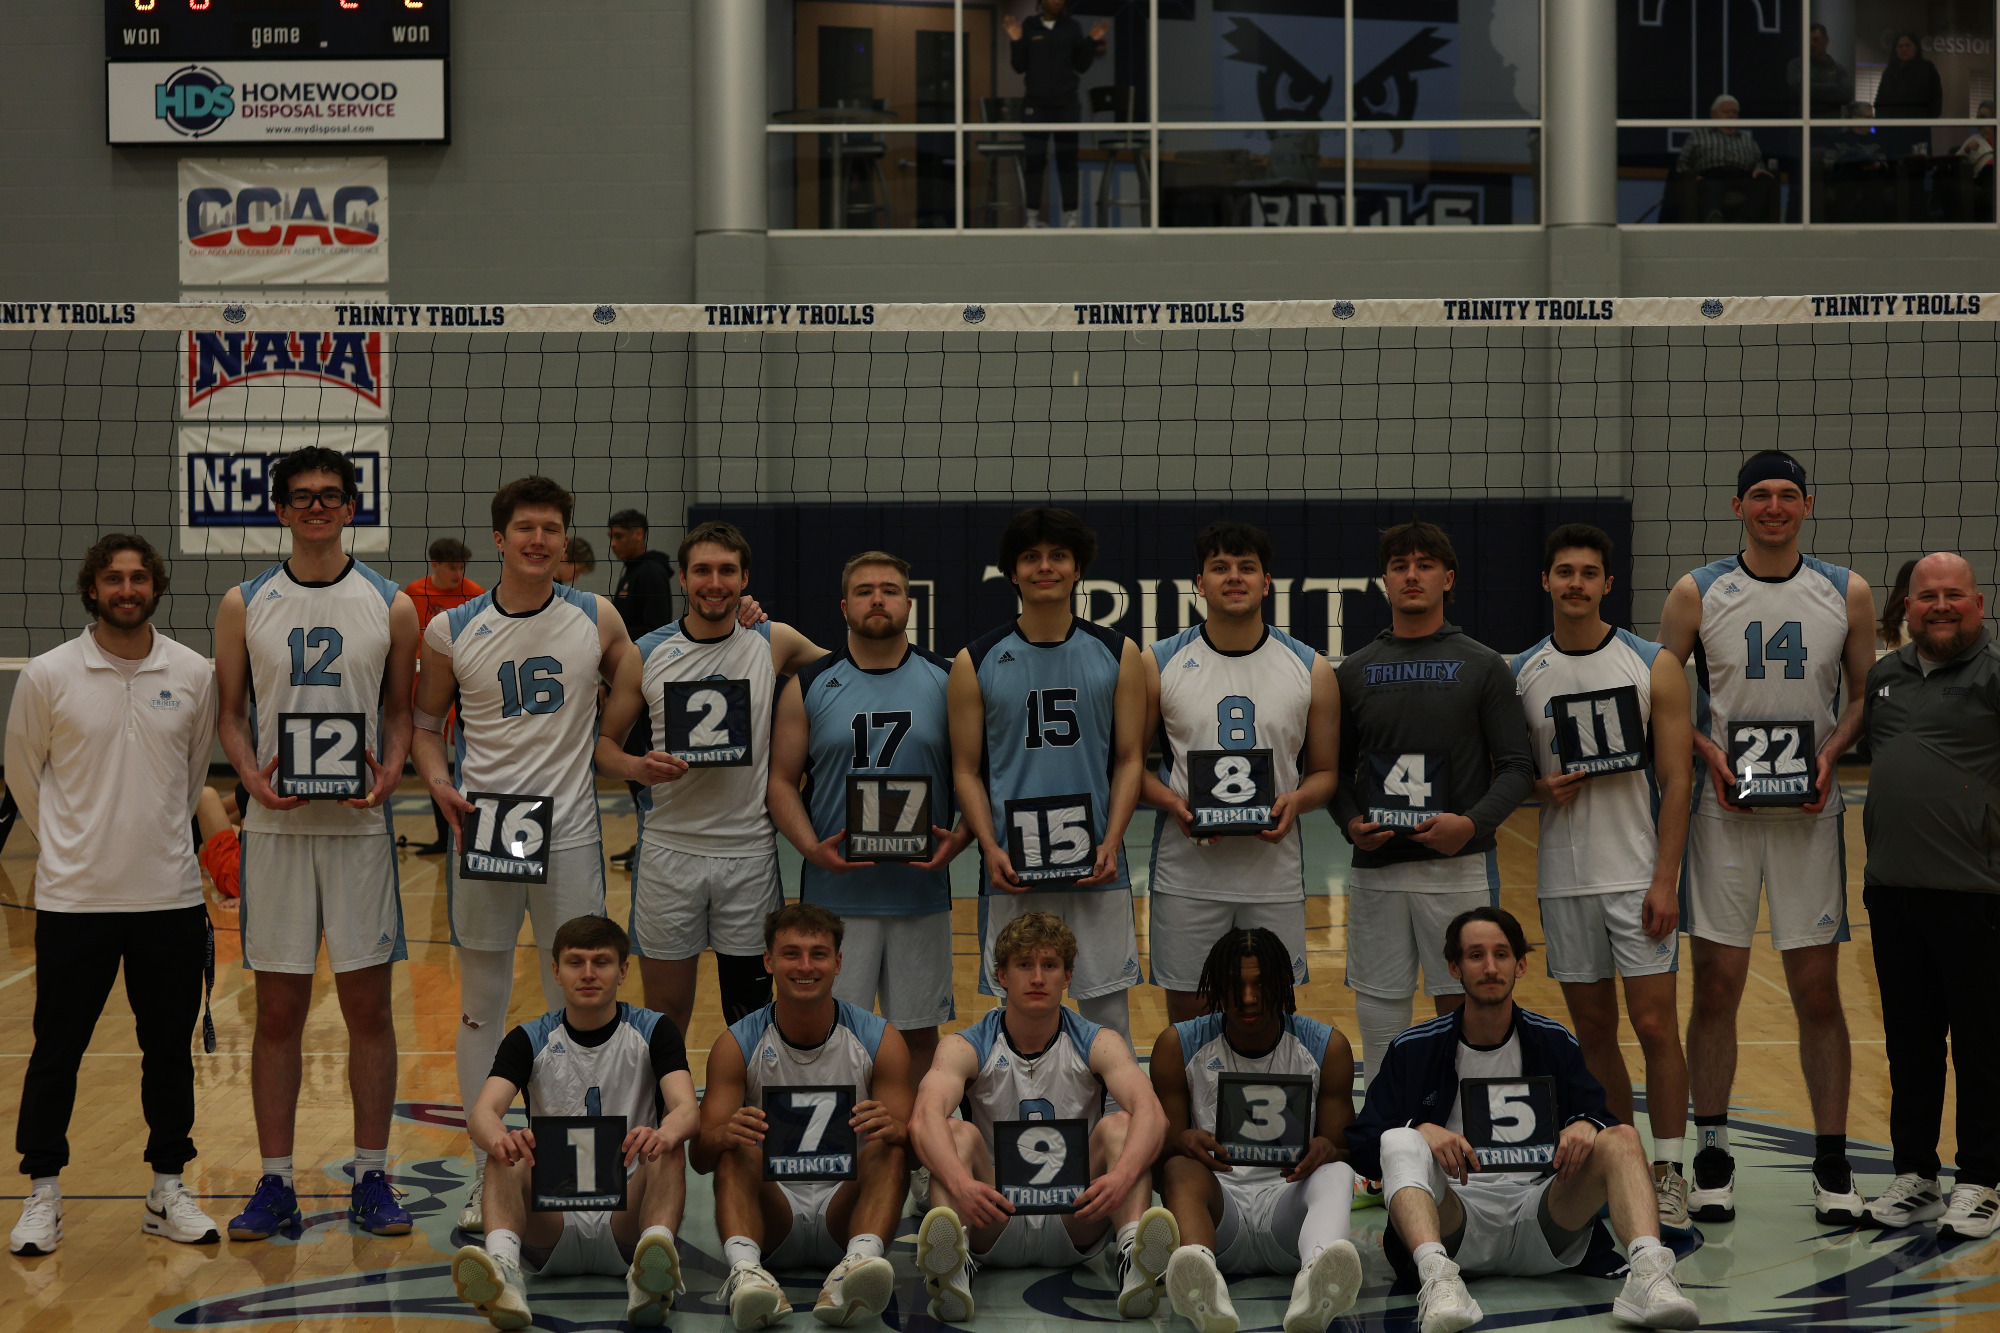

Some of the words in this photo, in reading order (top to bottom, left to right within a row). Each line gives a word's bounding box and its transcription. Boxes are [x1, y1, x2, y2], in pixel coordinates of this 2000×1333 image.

[122, 28, 160, 45] won
[251, 27, 301, 48] game
[392, 25, 430, 43] won
[155, 84, 235, 119] HDS
[242, 82, 398, 102] HOMEWOOD
[242, 104, 323, 118] DISPOSAL
[327, 103, 395, 118] SERVICE
[265, 124, 375, 135] www.mydisposal.com
[187, 186, 380, 247] CCAC
[0, 304, 52, 323] NITY
[57, 304, 135, 324] TROLLS
[334, 306, 421, 325] TRINITY
[426, 306, 505, 326] TROLLS
[705, 305, 791, 325] TRINITY
[796, 305, 874, 325] TROLLS
[1074, 304, 1161, 324] TRINITY
[1166, 303, 1244, 323] TROLLS
[1444, 300, 1530, 320] TRINITY
[1535, 300, 1613, 320] TROLLS
[1812, 296, 1898, 317] TRINITY
[1903, 294, 1980, 315] TROLLS
[195, 331, 374, 393] NAIA
[287, 627, 344, 687] 12
[1744, 621, 1807, 679] 14
[497, 655, 565, 718] 16
[1365, 661, 1462, 685] TRINITY
[686, 689, 730, 747] 2
[1025, 688, 1082, 750] 15
[1217, 695, 1256, 750] 8
[1567, 696, 1626, 758] 11
[285, 718, 359, 776] 12
[851, 710, 912, 769] 17
[1734, 727, 1807, 774] 22
[284, 779, 360, 794] TRINITY
[1211, 756, 1257, 804] 8
[1384, 754, 1432, 807] 4
[1737, 776, 1809, 796] TRINITY
[856, 781, 927, 832] 17
[1197, 806, 1271, 827] TRINITY
[474, 798, 544, 858] 16
[852, 835, 928, 853] TRINITY
[1013, 806, 1090, 868] 15
[467, 852, 542, 875] TRINITY
[791, 1092, 837, 1152] 7
[1239, 1085, 1287, 1142] 3
[1487, 1083, 1537, 1144] 5
[566, 1127, 597, 1192] 1
[770, 1154, 852, 1175] TRINITY
[1016, 1126, 1068, 1185] 9
[1225, 1144, 1303, 1163] TRINITY
[1475, 1145, 1555, 1165] TRINITY
[1003, 1185, 1086, 1206] TRINITY
